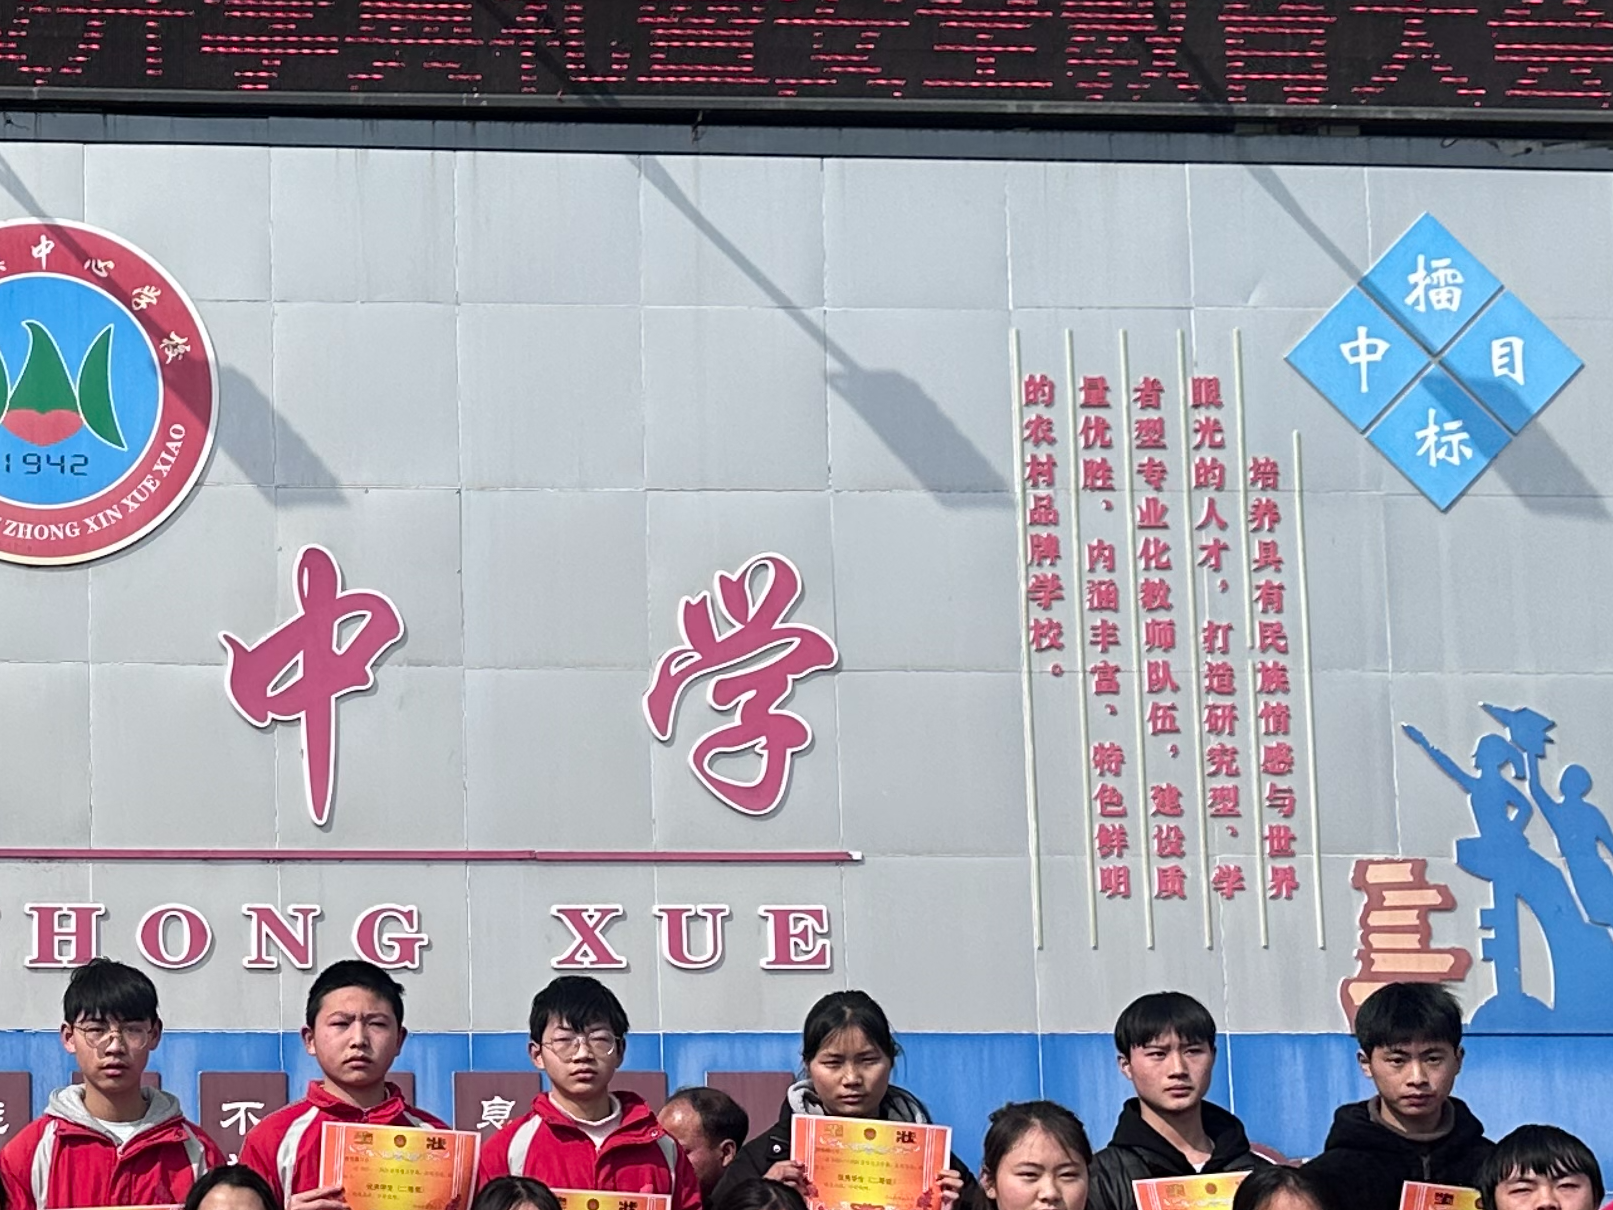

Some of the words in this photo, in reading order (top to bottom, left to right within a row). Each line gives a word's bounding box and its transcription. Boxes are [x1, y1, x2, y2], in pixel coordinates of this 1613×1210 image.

[3, 452, 89, 477] 1942
[3, 519, 82, 541] ZHONG
[85, 505, 124, 535] XIN
[123, 474, 161, 514] XUE
[152, 422, 187, 478] XIAO
[1022, 374, 1065, 677] 的农村品牌学校。
[1249, 456, 1299, 899] 培养具有民族情感与世界
[550, 904, 831, 970] XUE
